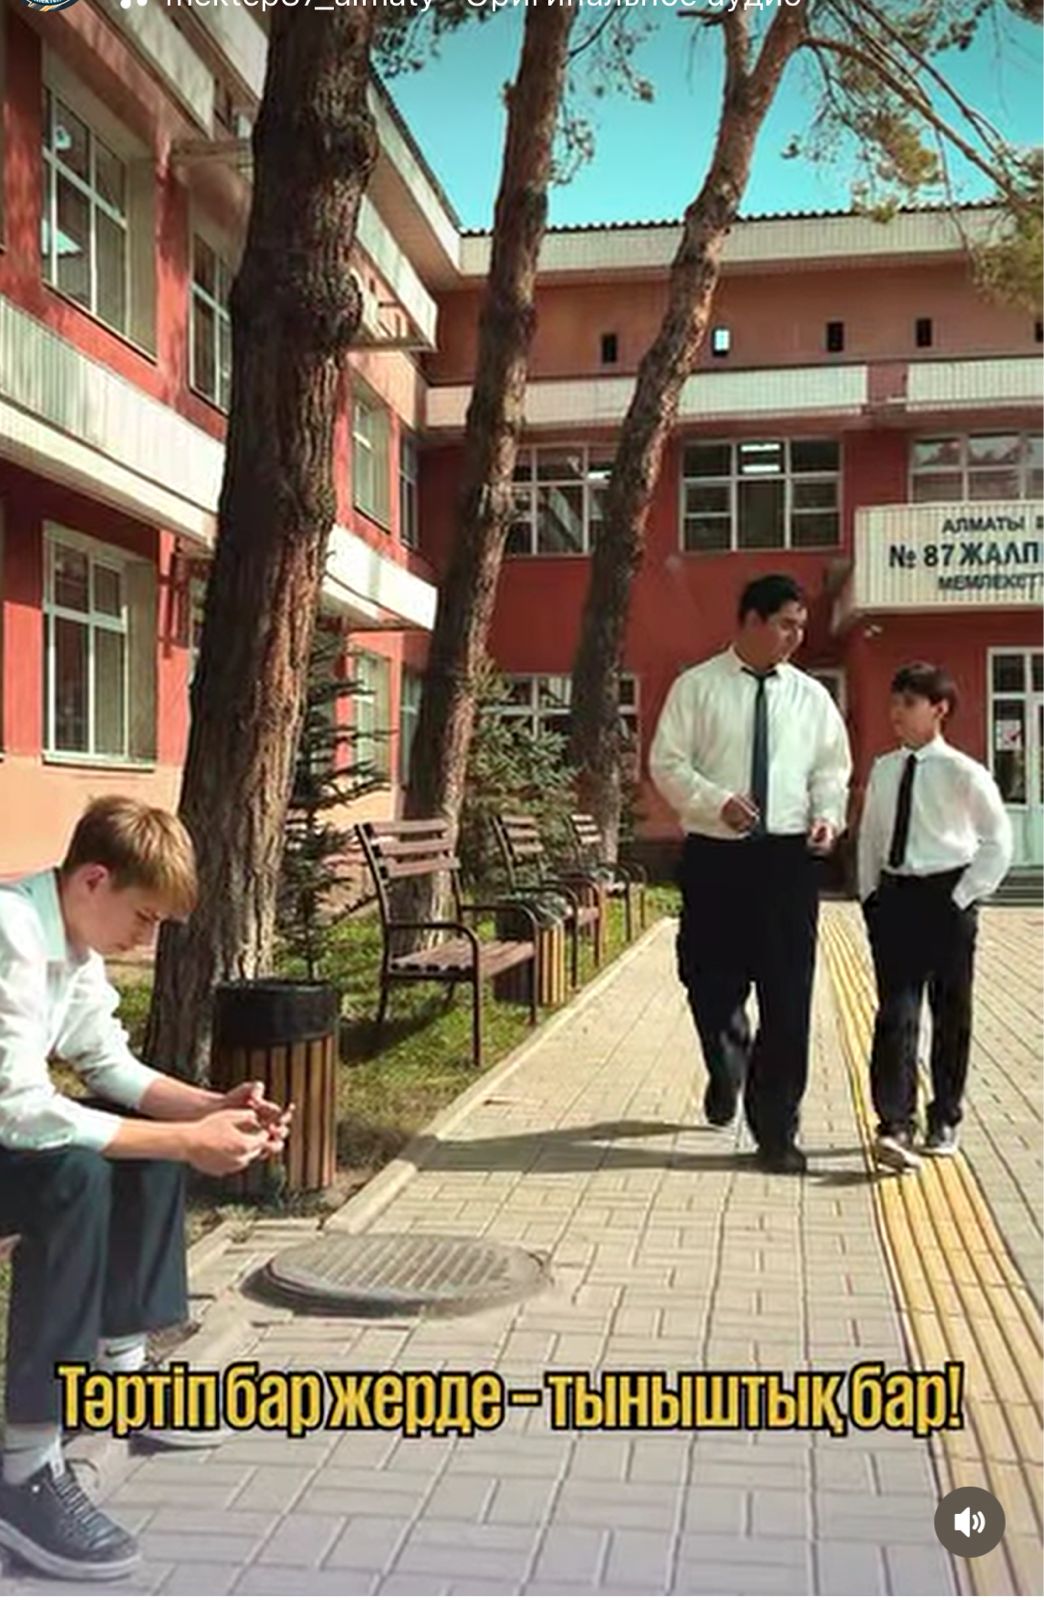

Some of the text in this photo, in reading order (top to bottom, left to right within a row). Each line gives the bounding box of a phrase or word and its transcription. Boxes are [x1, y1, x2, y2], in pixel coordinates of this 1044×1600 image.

[942, 516, 1024, 533] АЛМАТЫ
[888, 545, 917, 569] №
[923, 544, 955, 567] 87
